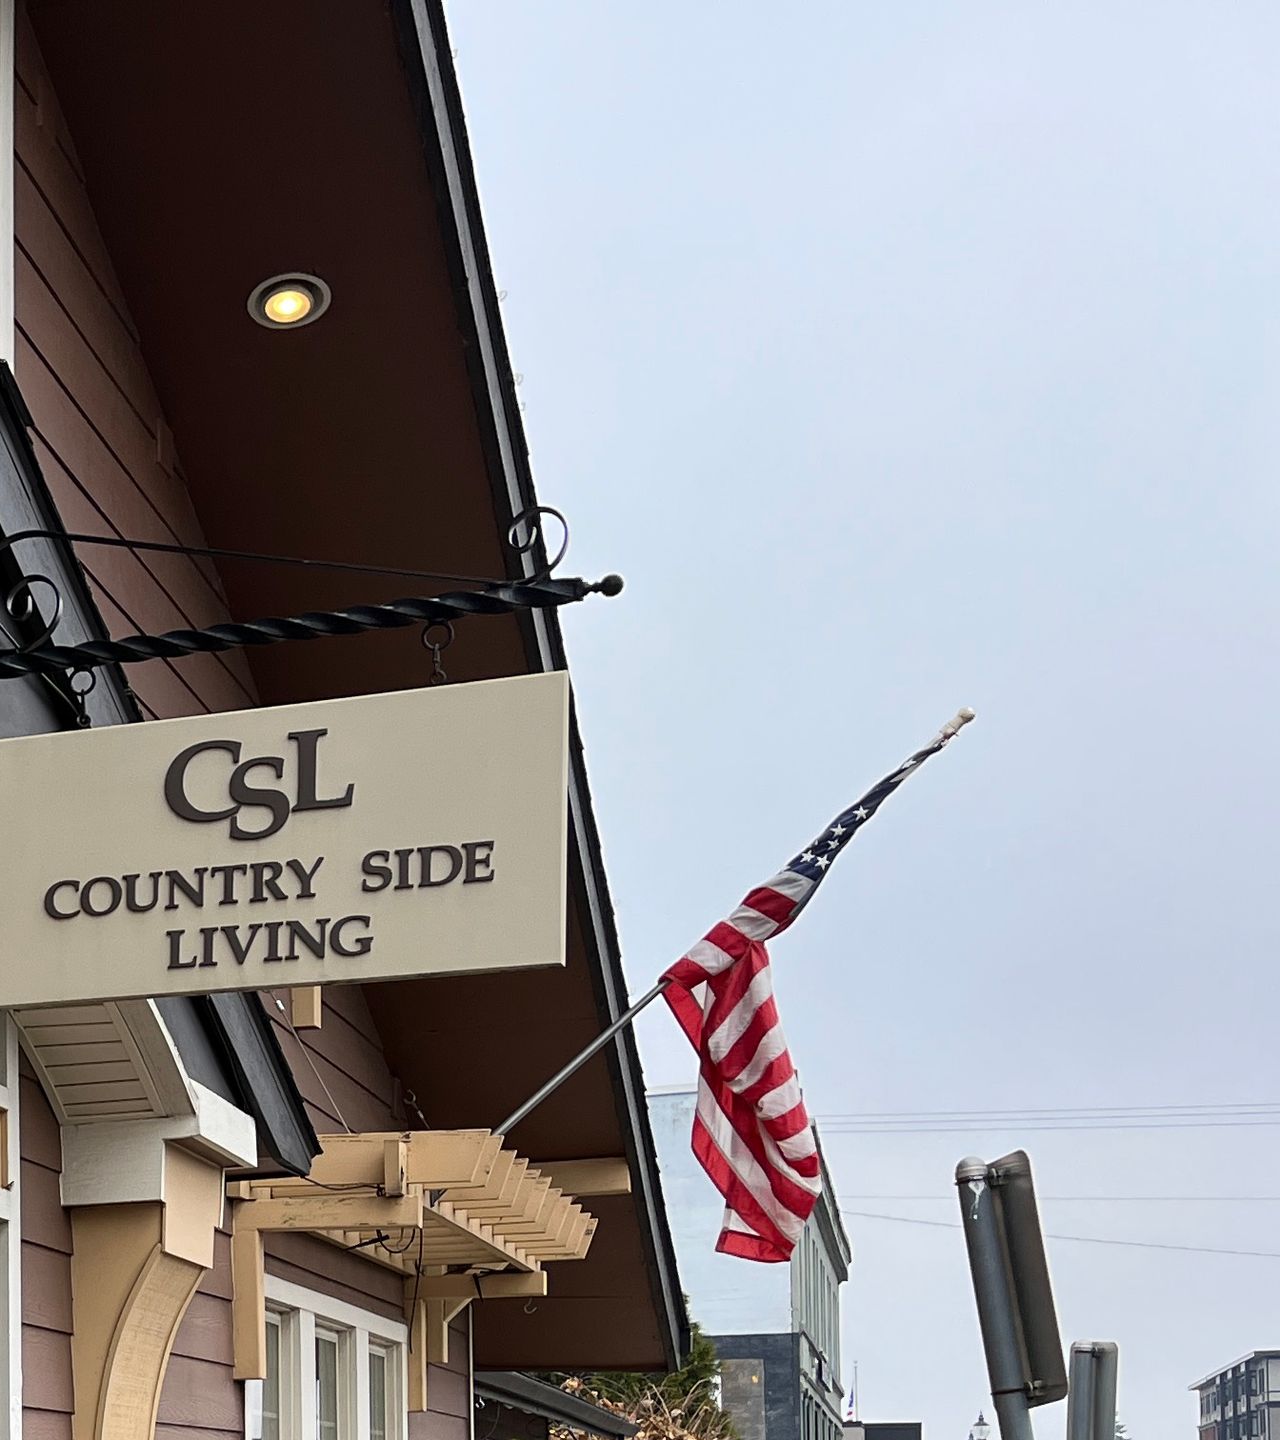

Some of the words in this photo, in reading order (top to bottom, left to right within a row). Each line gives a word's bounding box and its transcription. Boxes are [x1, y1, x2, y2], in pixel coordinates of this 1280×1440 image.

[164, 728, 354, 841] CSL
[43, 856, 324, 920] COUNTRY
[361, 840, 495, 893] SIDE
[166, 915, 374, 970] LIVING
